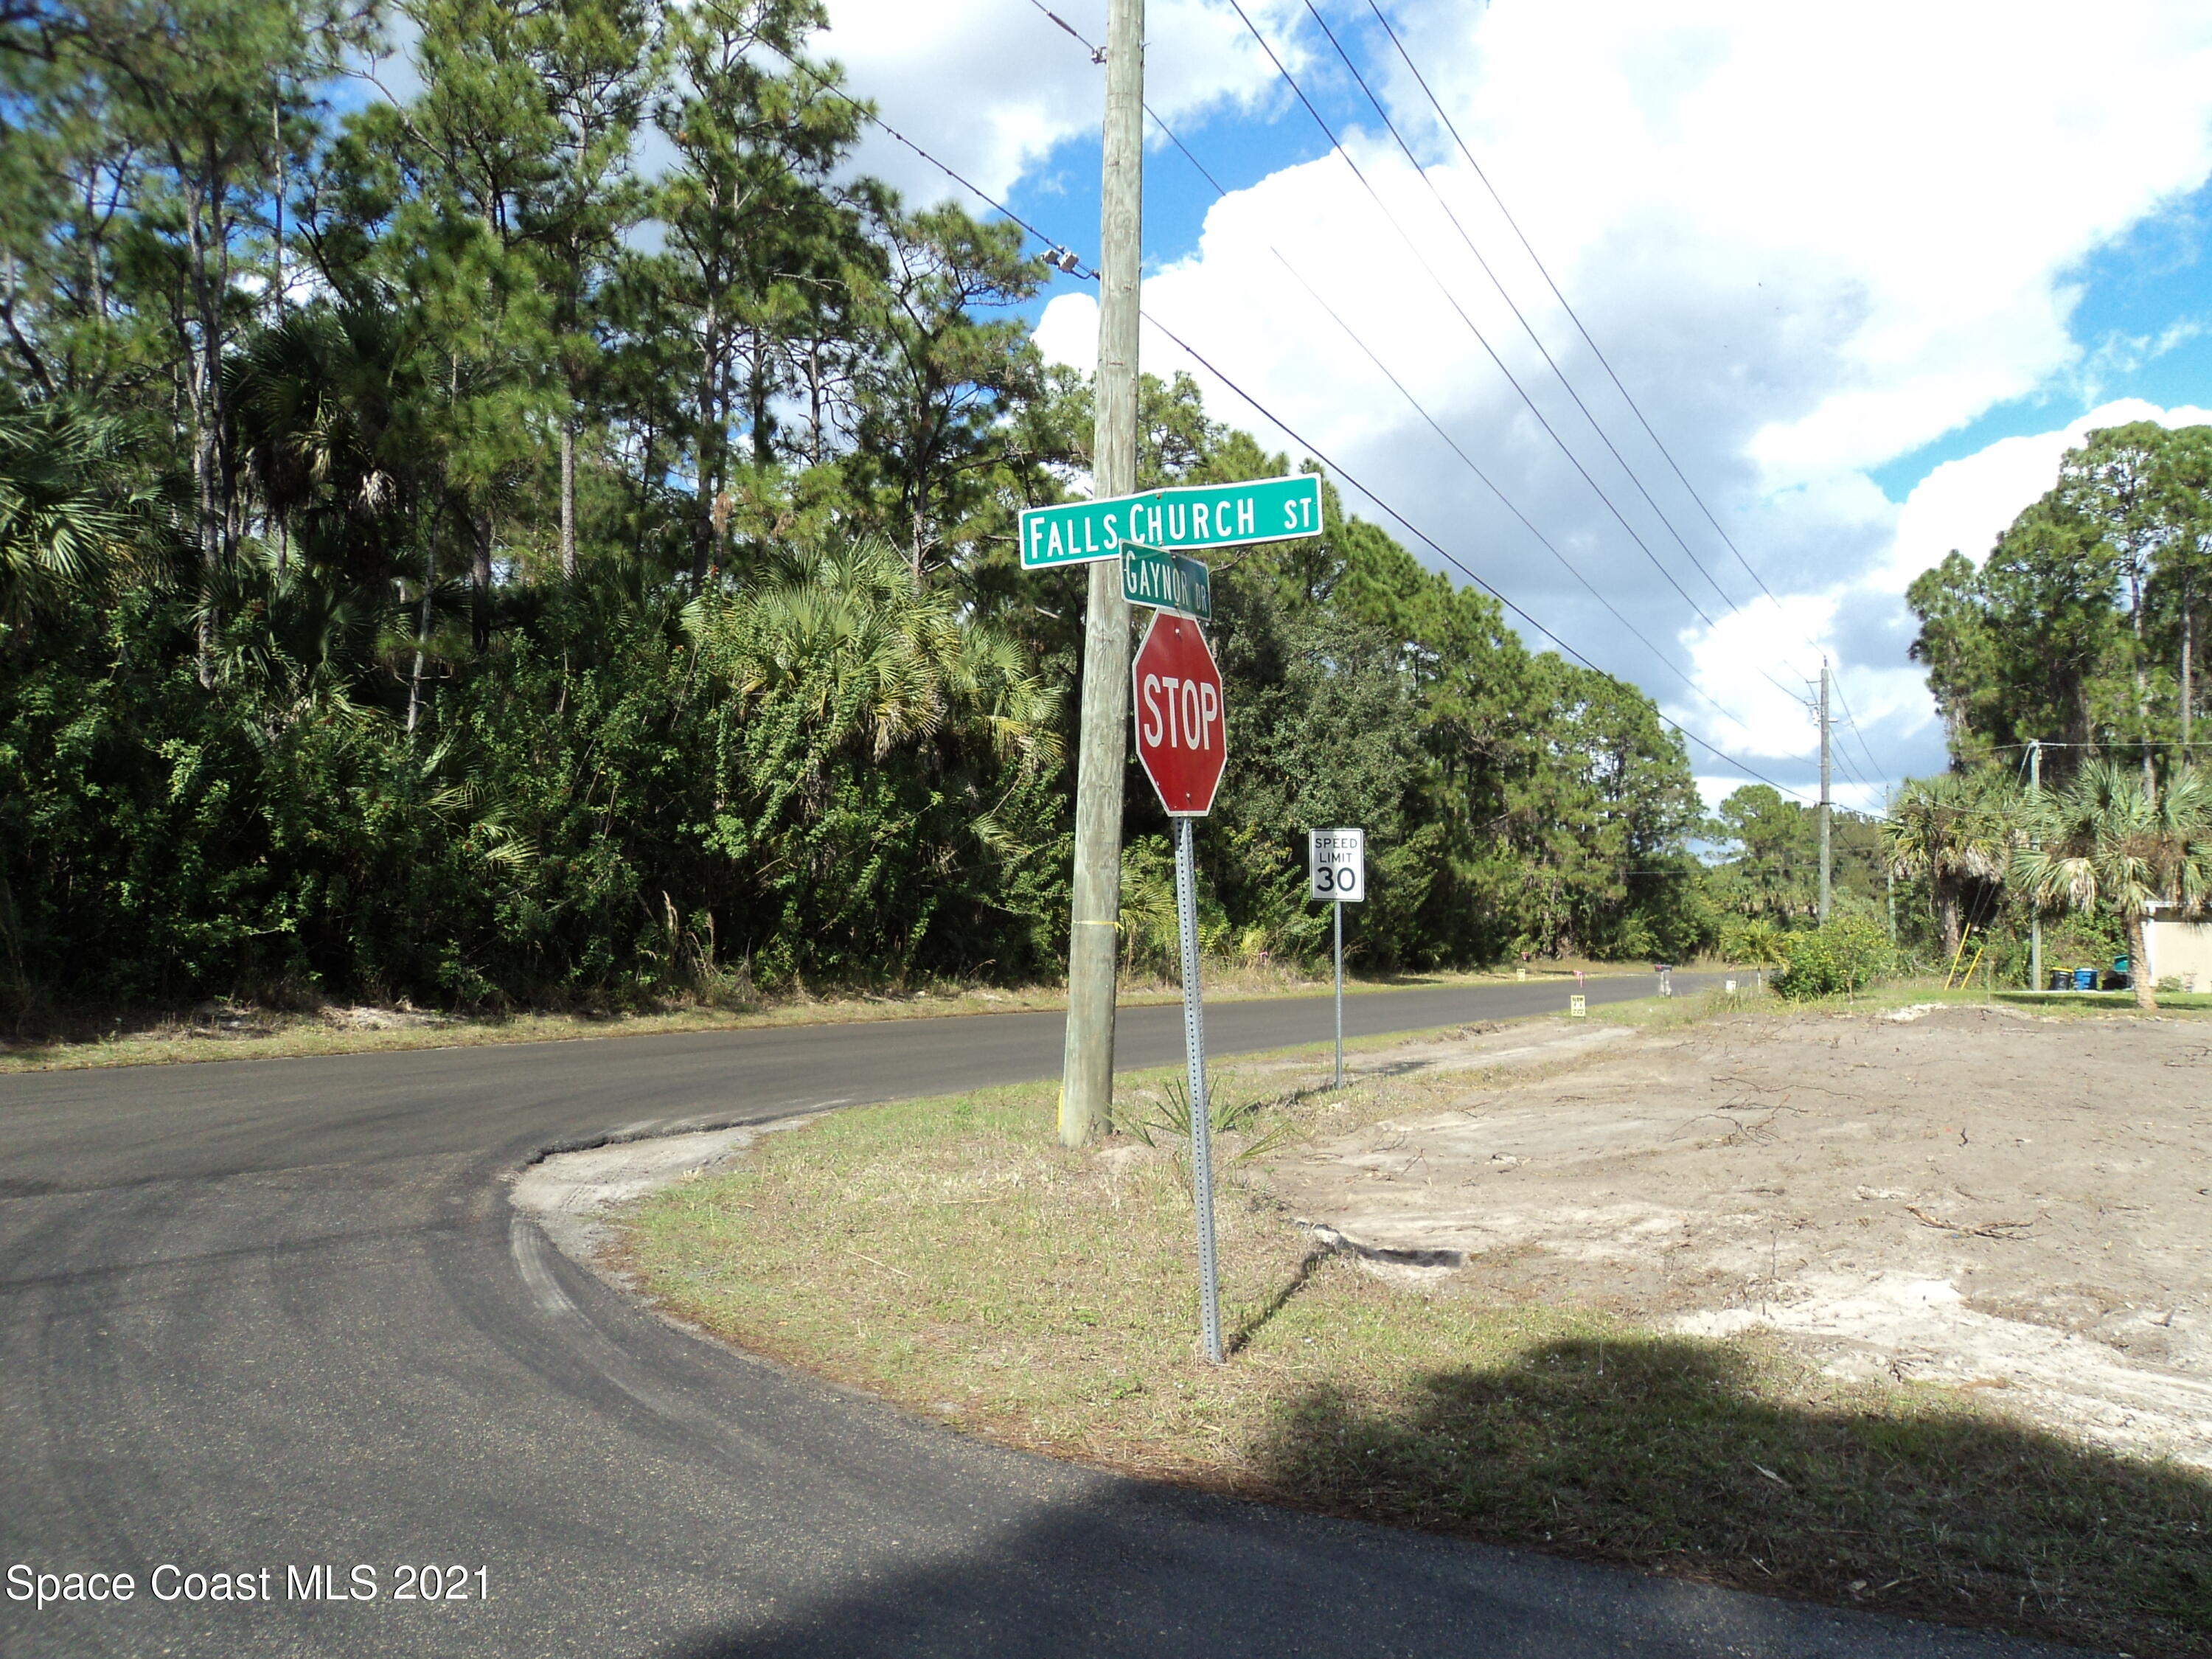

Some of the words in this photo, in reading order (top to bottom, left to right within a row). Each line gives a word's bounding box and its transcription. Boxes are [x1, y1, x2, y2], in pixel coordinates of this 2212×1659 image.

[1030, 514, 1118, 559] FALLS
[1130, 498, 1254, 543] CHURCH
[1284, 498, 1312, 529] ST
[1126, 550, 1189, 605] GAYNOR
[1195, 582, 1208, 612] DR
[1143, 674, 1217, 751] STOP
[1315, 838, 1357, 849] SPEED
[1319, 852, 1352, 863] LIMIT
[1316, 866, 1355, 892] 30
